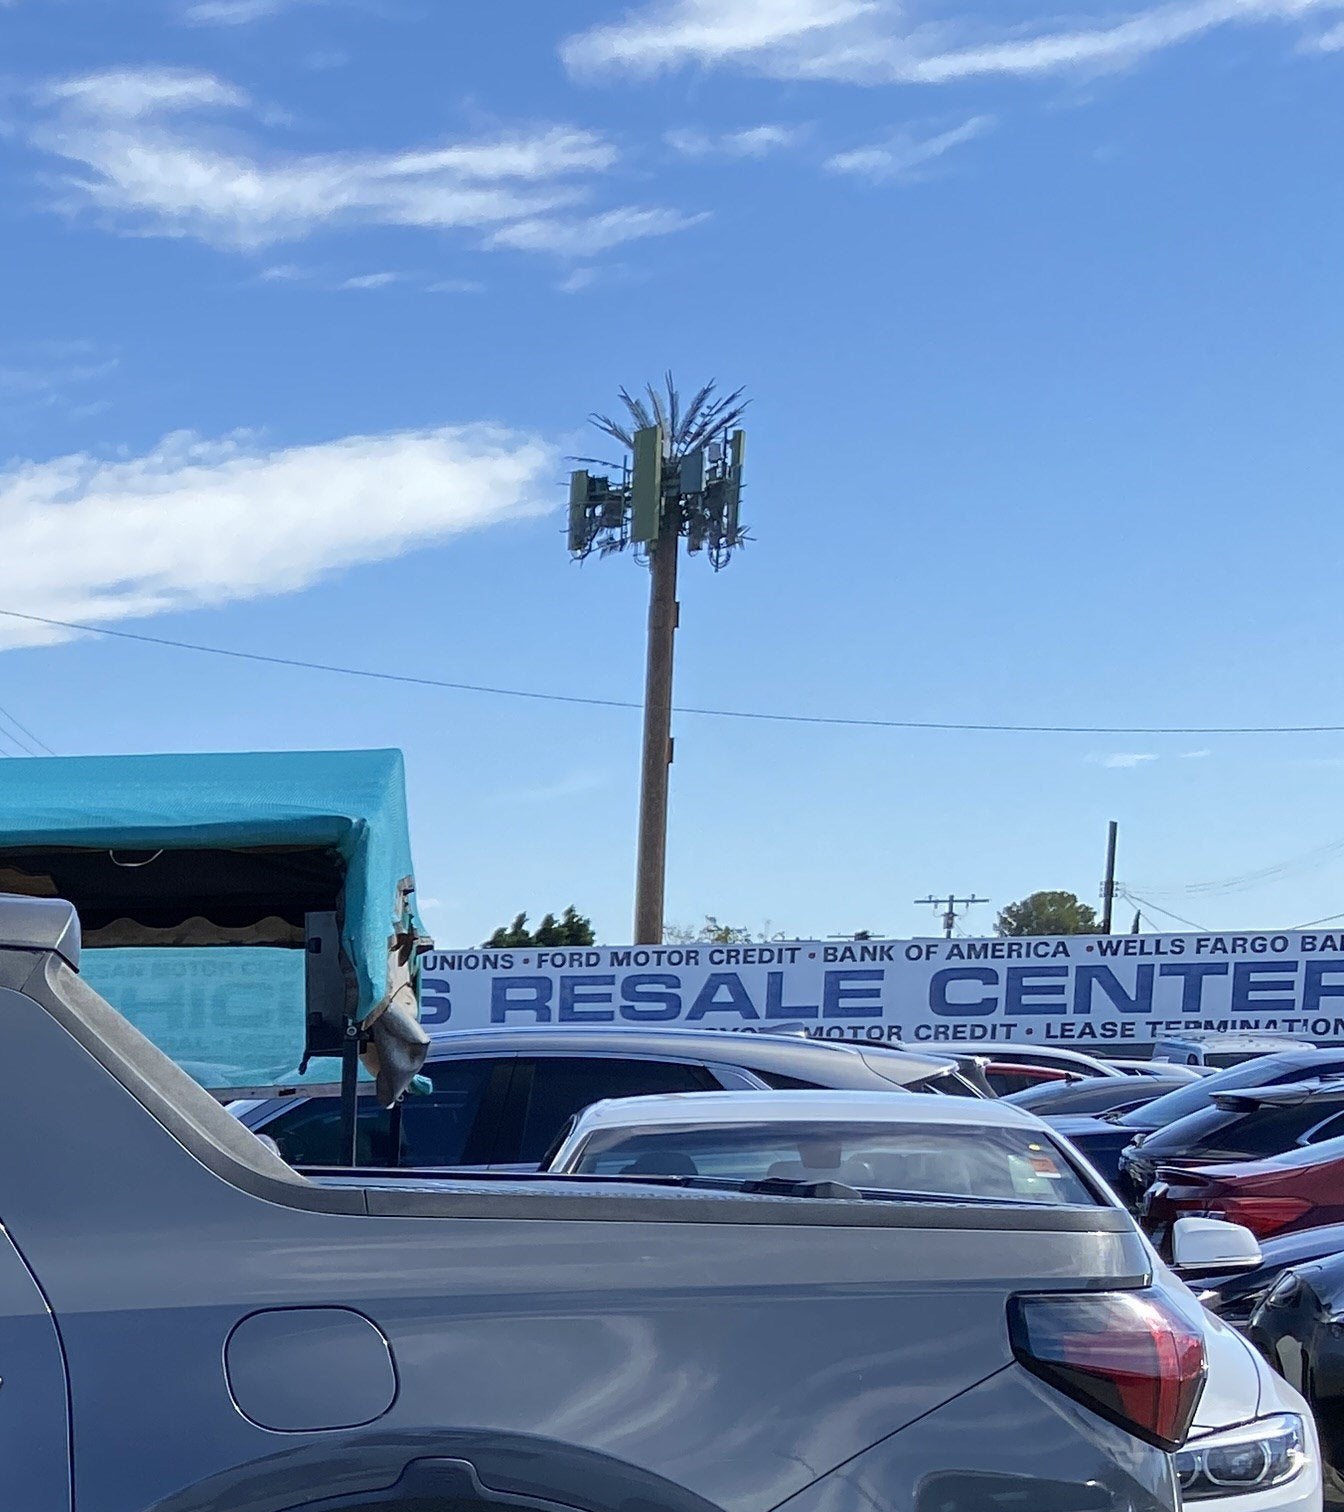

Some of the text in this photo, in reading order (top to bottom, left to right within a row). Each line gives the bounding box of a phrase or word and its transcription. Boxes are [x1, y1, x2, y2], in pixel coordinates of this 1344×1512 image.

[422, 933, 1344, 971] UNIONS FORD MOTOR CREDIT BANK OF AMERICA WELLS FARGO BA
[490, 968, 885, 1024] RESALE
[913, 1022, 1018, 1041] CREDIT
[1044, 1021, 1137, 1040] LEASE
